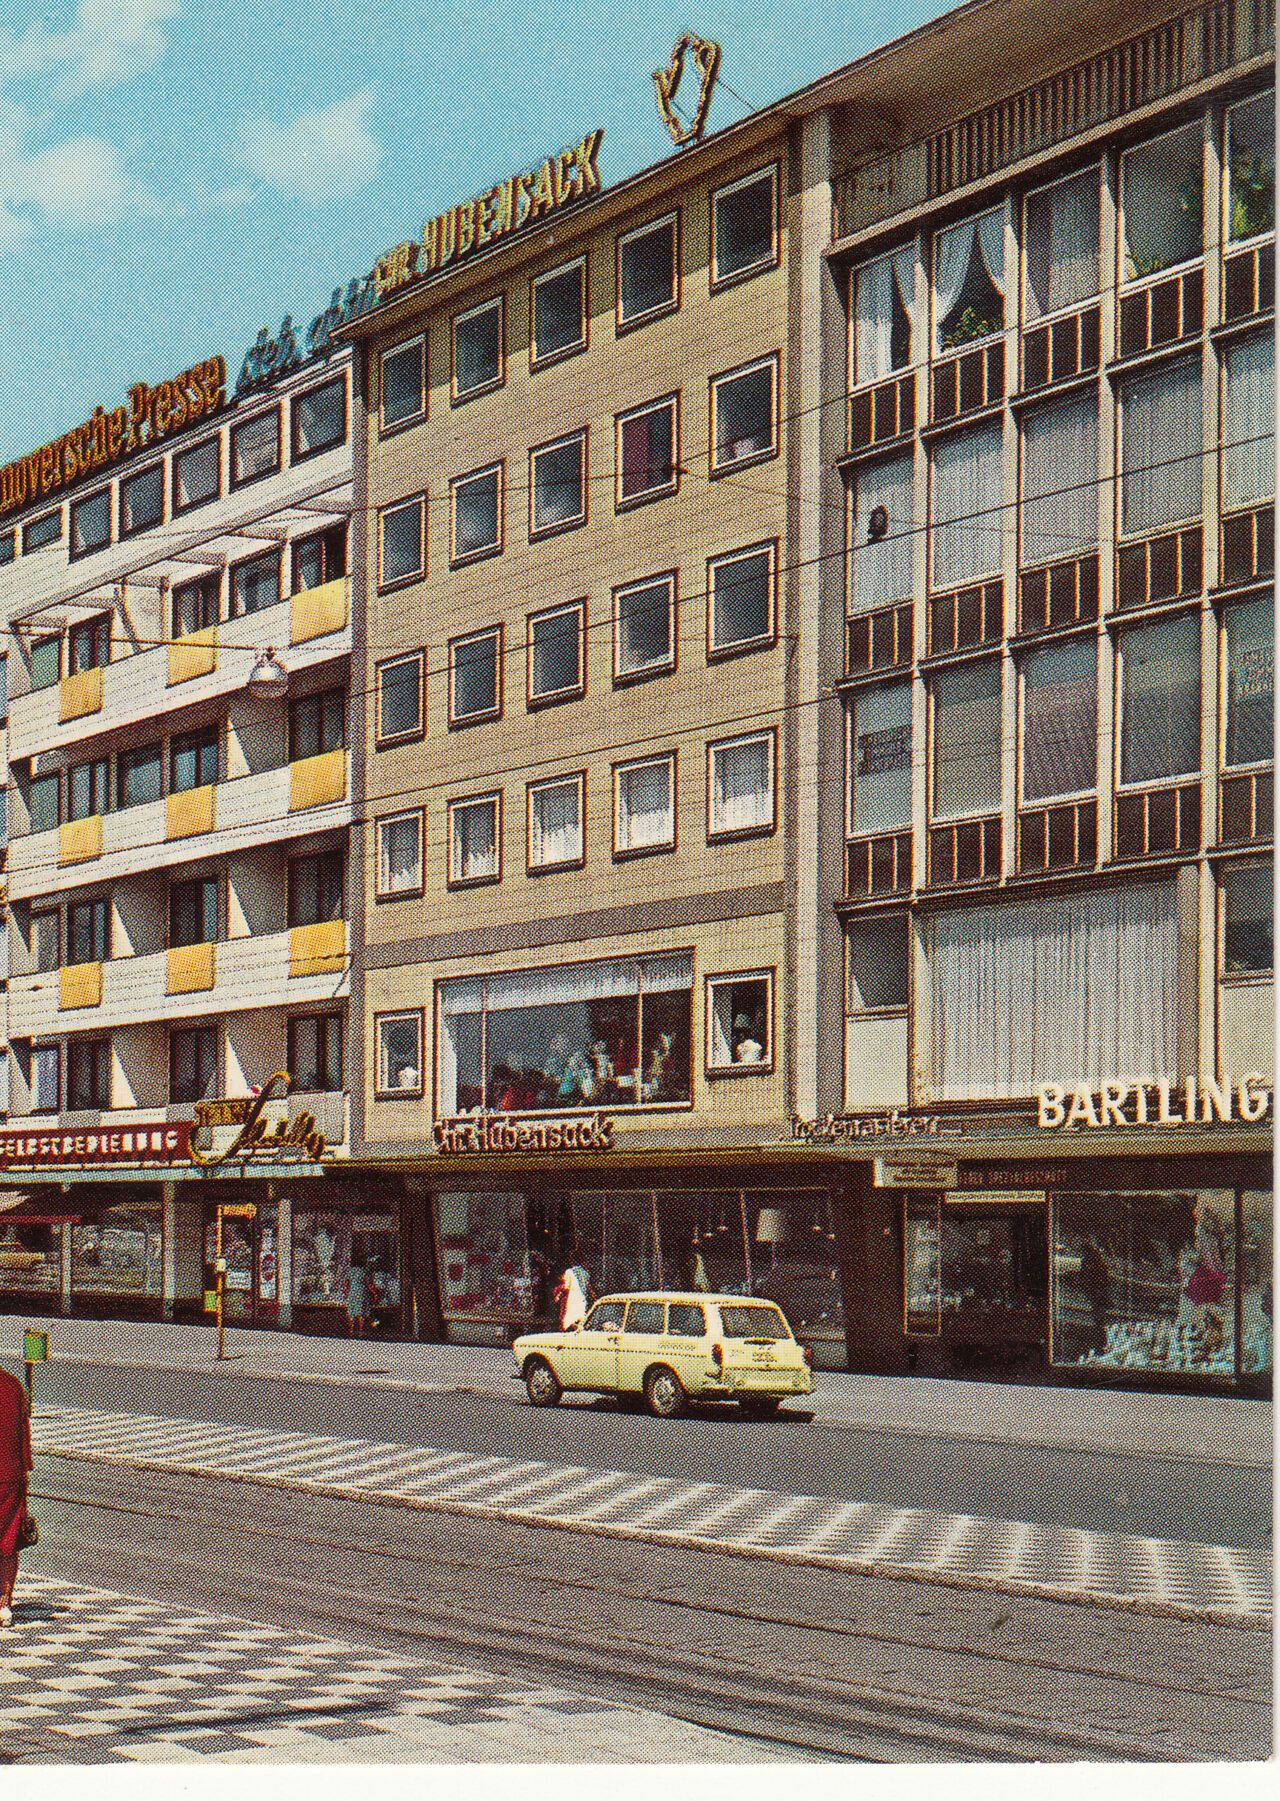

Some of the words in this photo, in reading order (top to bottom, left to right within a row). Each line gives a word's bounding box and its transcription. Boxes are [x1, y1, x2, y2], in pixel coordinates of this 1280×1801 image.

[423, 129, 605, 273] HUBENSACK
[126, 355, 228, 447] Presse
[1037, 1071, 1271, 1129] BARTLING
